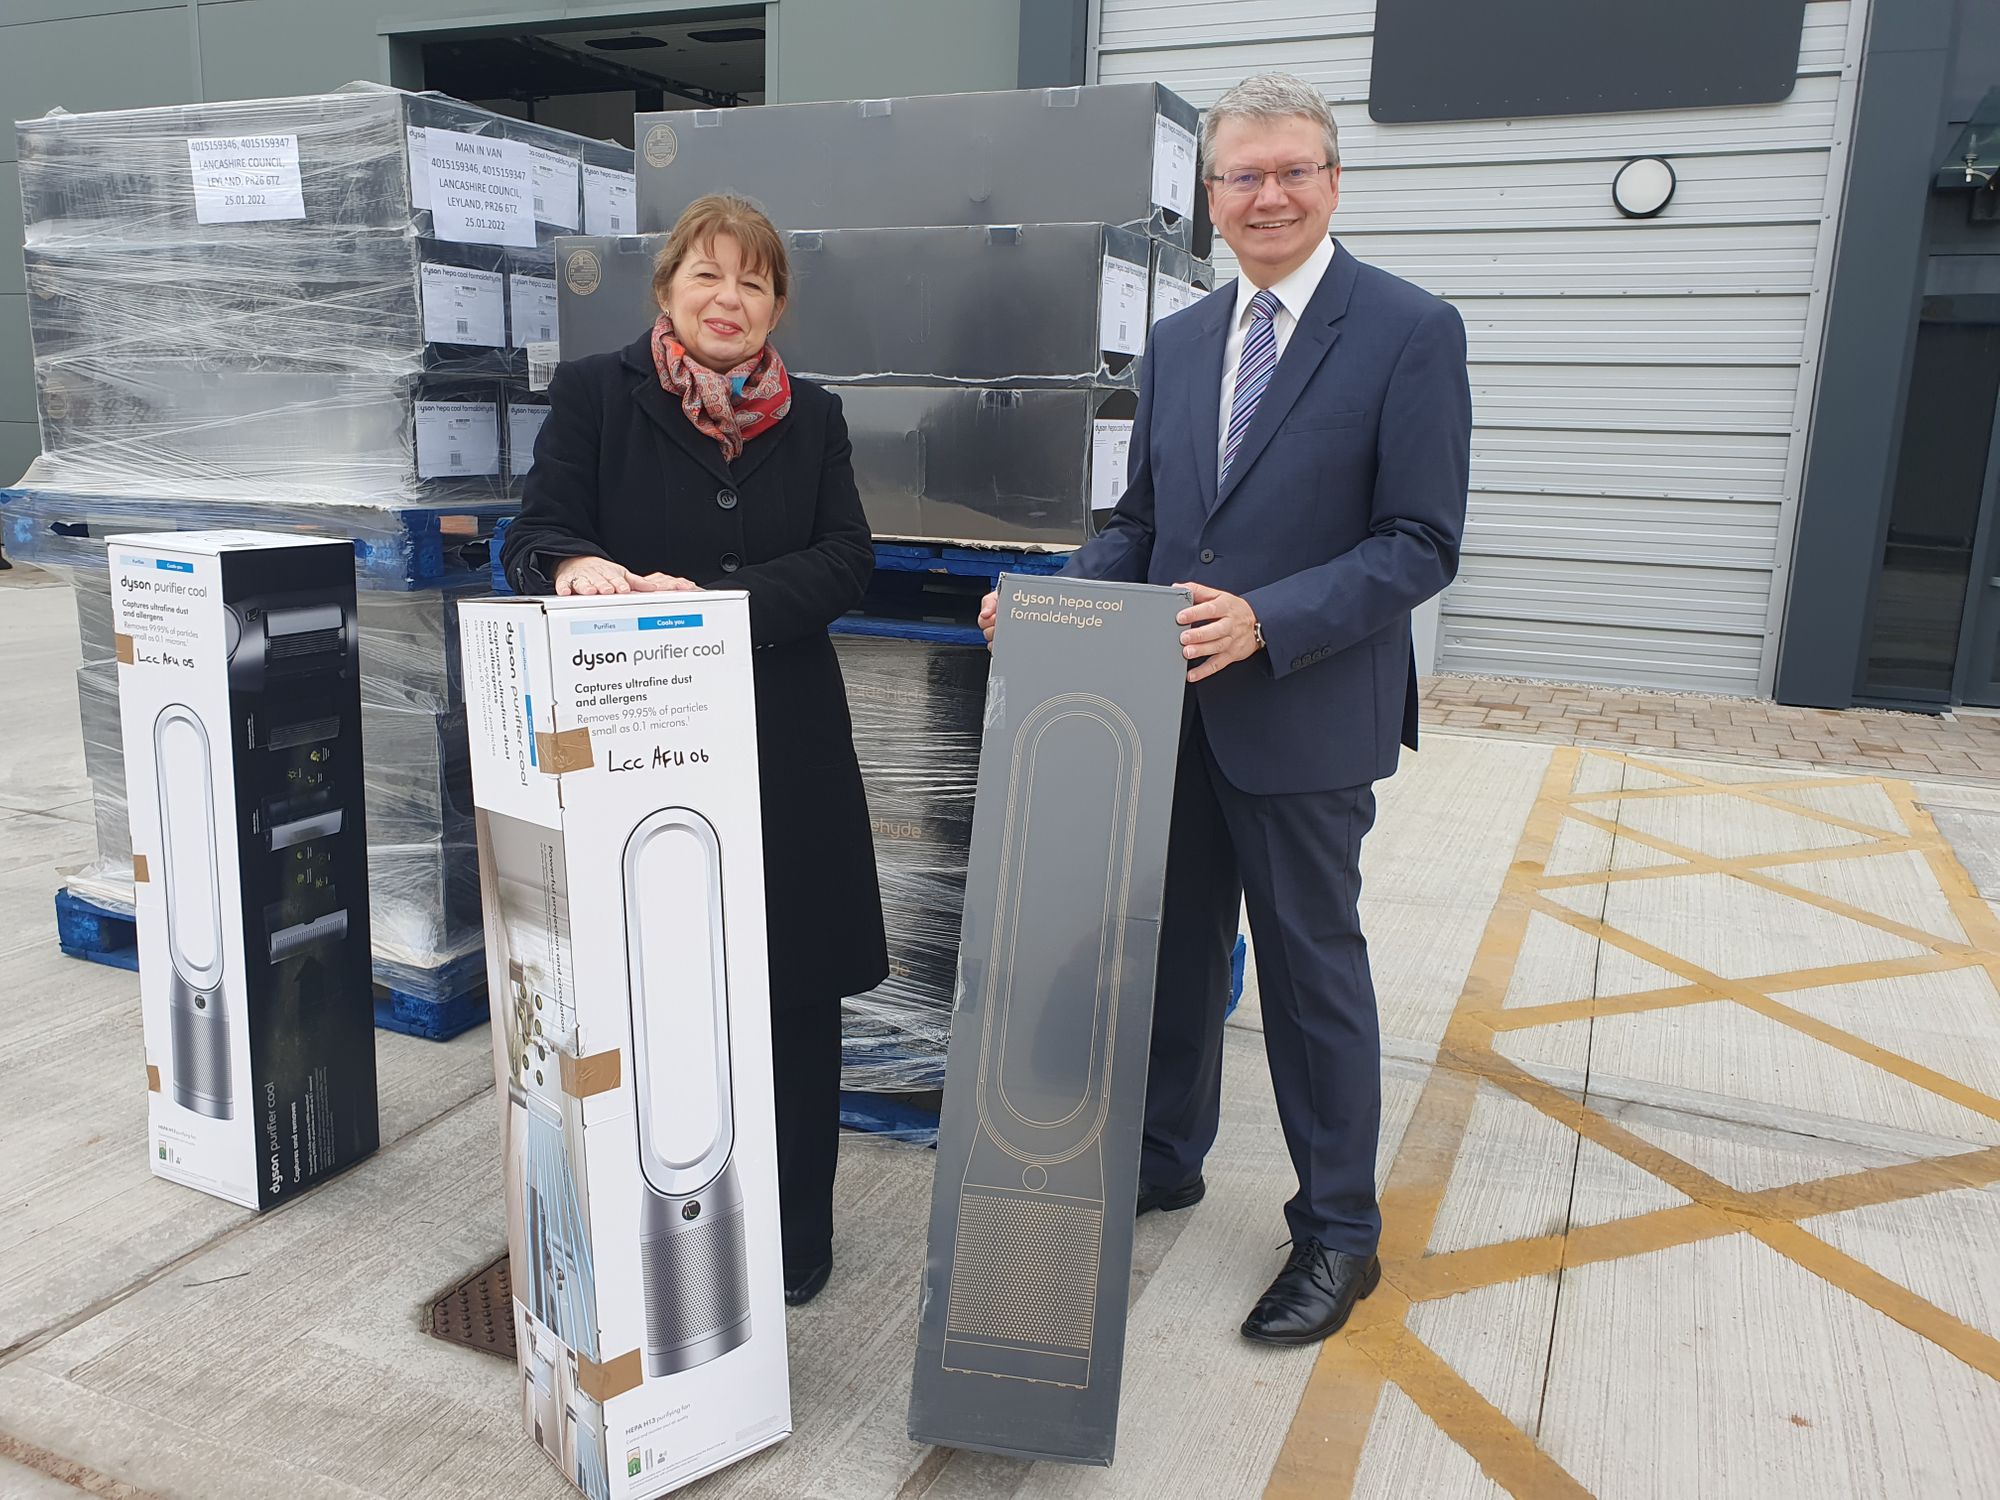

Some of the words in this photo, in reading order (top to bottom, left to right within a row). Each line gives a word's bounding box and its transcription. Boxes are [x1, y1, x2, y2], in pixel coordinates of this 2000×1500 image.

[409, 129, 425, 139] dyso
[191, 139, 240, 151] 4015159346,
[241, 137, 289, 149] 4015159347
[455, 142, 475, 154] MAN
[477, 145, 485, 156] IN
[486, 147, 503, 158] VAN
[200, 159, 246, 170] LANCASHIRE
[431, 158, 481, 175] 4015159346,
[482, 165, 526, 180] 4015159347
[267, 176, 281, 185] 6TZ
[439, 178, 486, 193] LANCASHIRE
[488, 185, 522, 199] COUNCIL,
[225, 195, 266, 205] 25.01.2022
[448, 196, 483, 210] LEYLAND,
[485, 201, 503, 212] PR26
[505, 204, 518, 214] 6TZ
[465, 218, 505, 231] 25.01.2022
[423, 265, 441, 276] dyson
[442, 267, 457, 277] hepa
[120, 575, 151, 592] dyson
[154, 582, 187, 595] purifier
[188, 586, 207, 598] cool
[122, 599, 149, 611] Captures
[150, 603, 175, 614] ultrafine
[175, 606, 189, 615] dust
[1012, 589, 1054, 606] dyson
[1059, 594, 1093, 611] hepa
[1095, 599, 1123, 612] cool
[136, 611, 164, 622] allergens
[1010, 607, 1103, 629] formaldehyde
[493, 621, 501, 676] Captures
[505, 621, 516, 679] dyson
[572, 649, 627, 671] dyson
[633, 643, 689, 666] purifier
[692, 639, 725, 657] cool
[183, 659, 195, 668] 05
[574, 681, 623, 696] Captures
[625, 676, 669, 690] ultrafine
[671, 674, 693, 685] dust
[575, 696, 597, 708] and
[599, 692, 648, 706] allergens
[510, 685, 523, 747] purifier
[577, 713, 620, 725] Removes
[621, 706, 657, 720] 99.95%
[659, 705, 669, 716] of
[670, 702, 708, 717] particles
[591, 724, 617, 737] small
[619, 726, 630, 734] as
[632, 721, 646, 733] 0.1
[690, 748, 709, 763] 06
[519, 750, 528, 787] cool
[264, 1081, 276, 1108] cool
[267, 1110, 280, 1151] purifier
[269, 1154, 283, 1194] dyson
[625, 1423, 643, 1435] HEPA
[643, 1417, 656, 1428] H13
